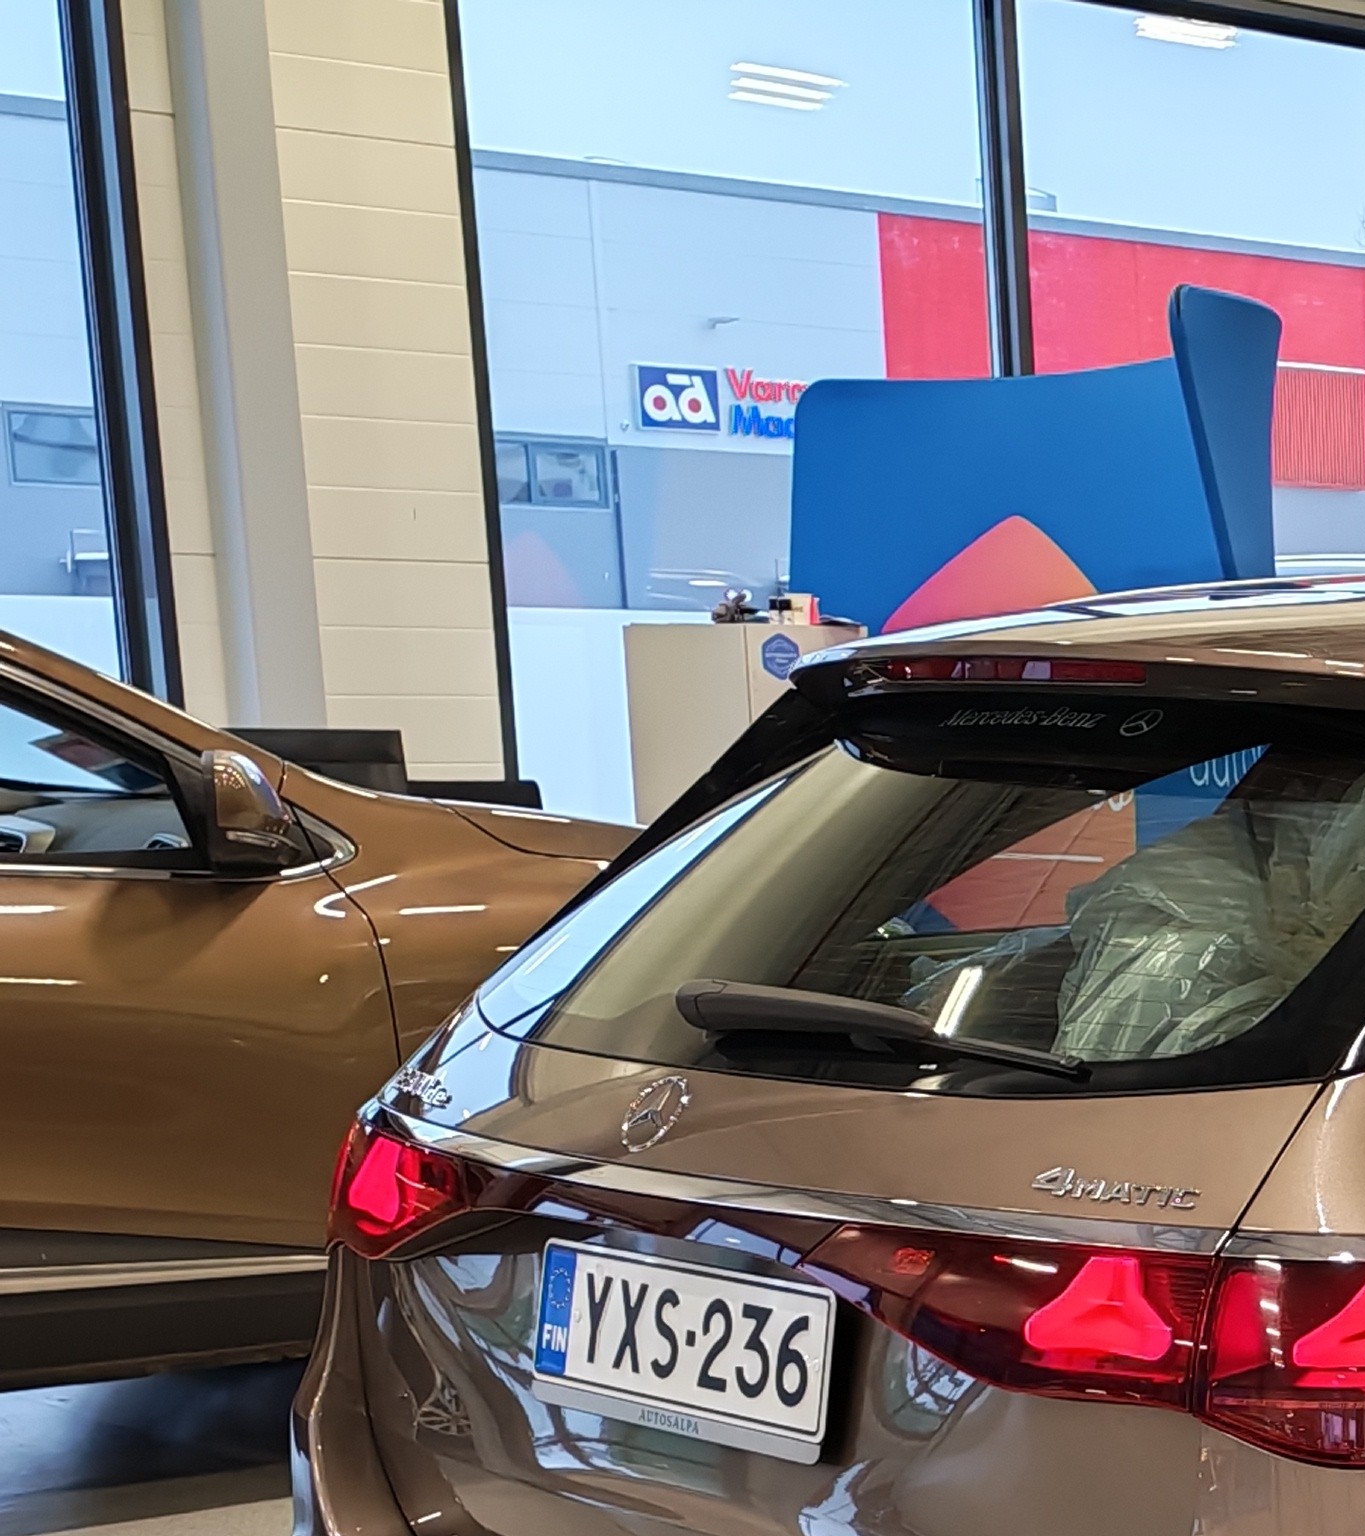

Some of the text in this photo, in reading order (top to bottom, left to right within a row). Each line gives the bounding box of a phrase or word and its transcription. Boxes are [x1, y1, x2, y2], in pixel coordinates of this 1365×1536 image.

[938, 706, 1107, 728] Mercedes-Benz
[1031, 1166, 1201, 1209] 4MATIC
[542, 1272, 811, 1408] FIN YXS-236
[639, 1408, 699, 1435] AUTOSALPA
